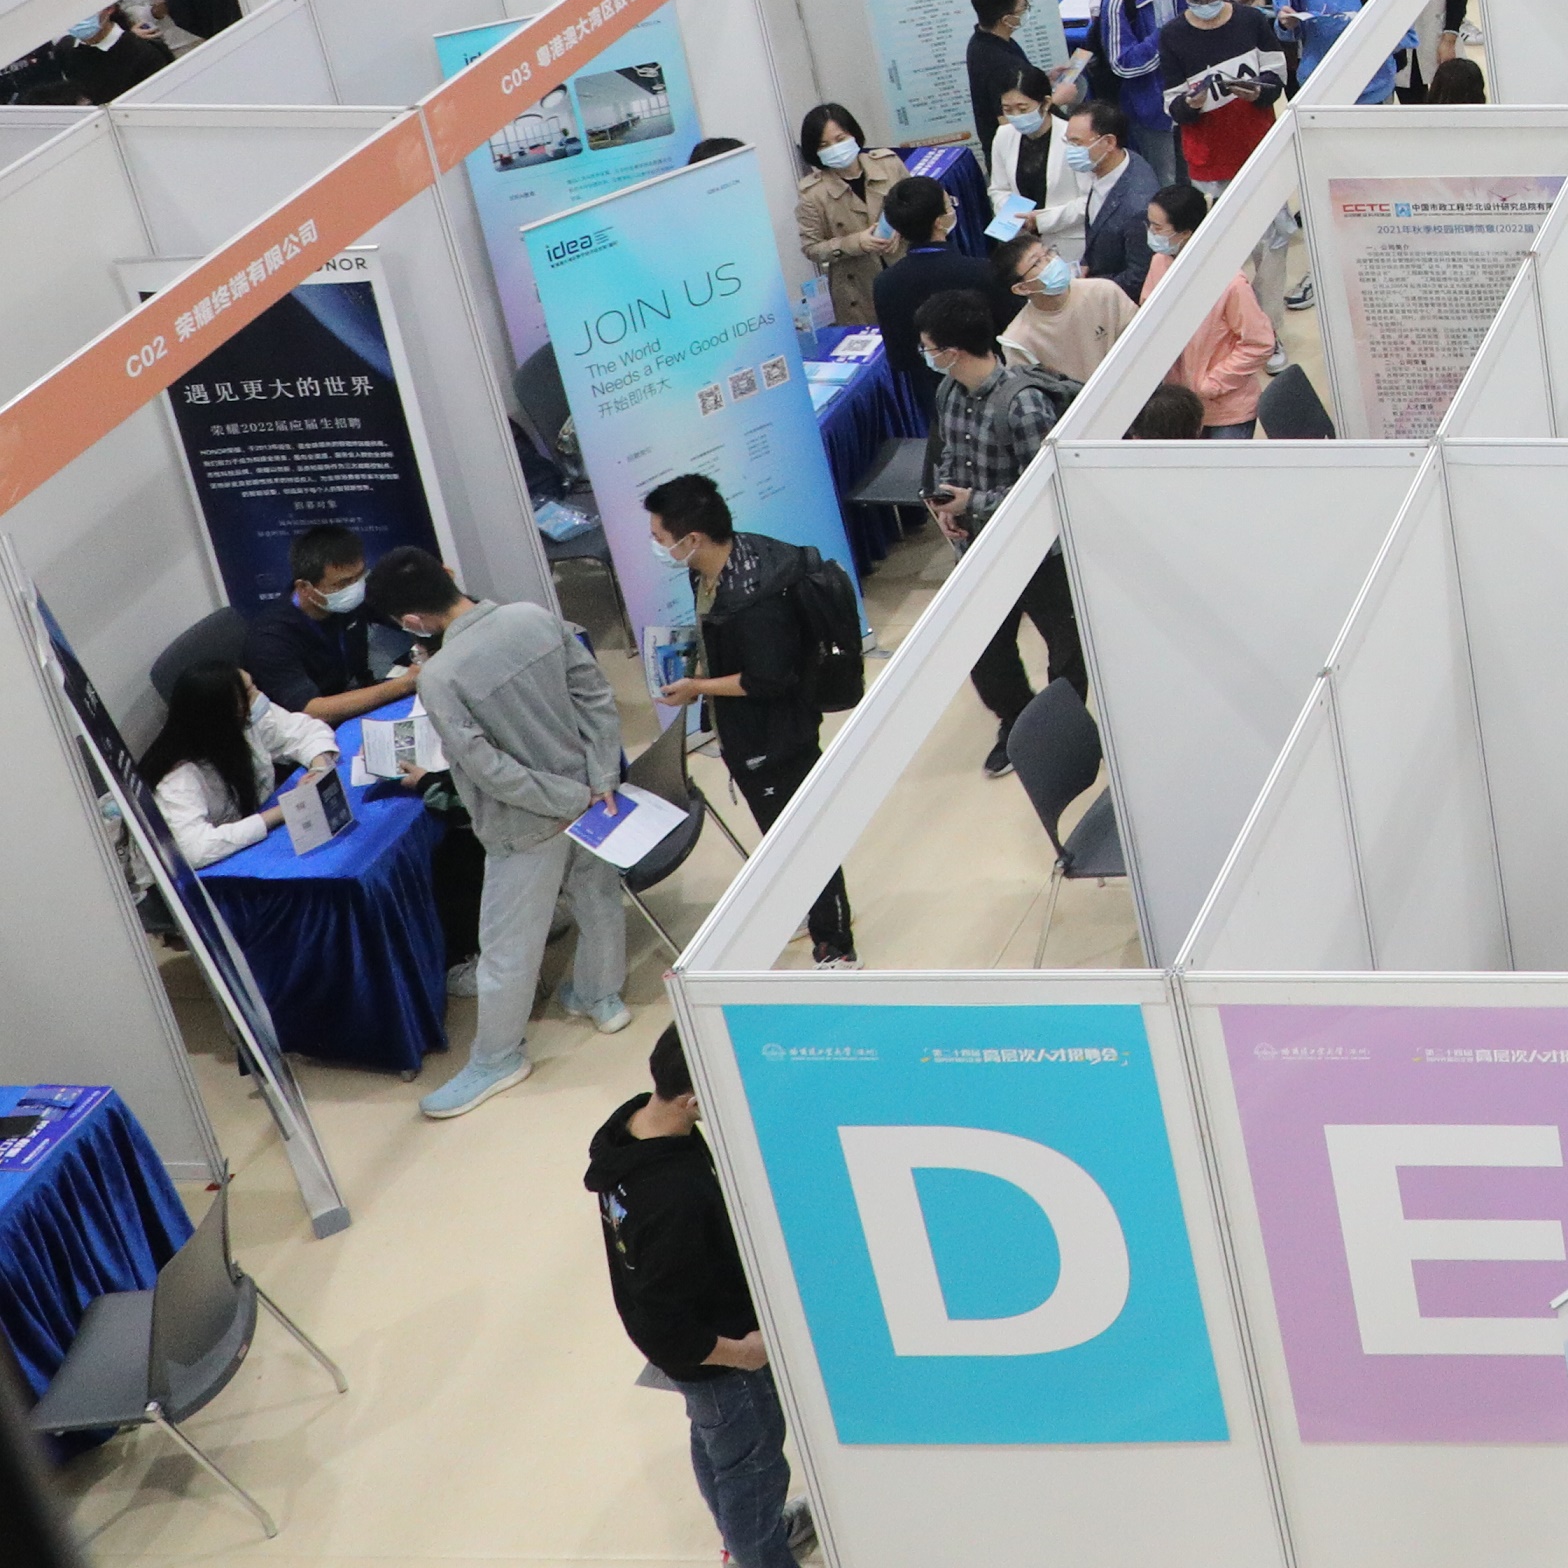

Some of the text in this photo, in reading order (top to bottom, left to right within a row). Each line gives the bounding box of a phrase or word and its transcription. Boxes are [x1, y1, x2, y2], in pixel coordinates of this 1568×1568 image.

[501, 61, 533, 95] C03
[545, 233, 593, 263] idea
[126, 218, 319, 378] C02 荣耀终端有限公司
[574, 262, 742, 357] JOIN US
[586, 338, 662, 379] The World
[591, 311, 777, 398] Needs a Few Good IDEAs
[184, 375, 375, 405] 遇见更大的世界
[598, 378, 674, 419] 开始即伟大
[983, 1048, 1118, 1066] 高层次人才招聘会
[837, 1124, 1131, 1358] D
[1323, 1124, 1564, 1356] E
